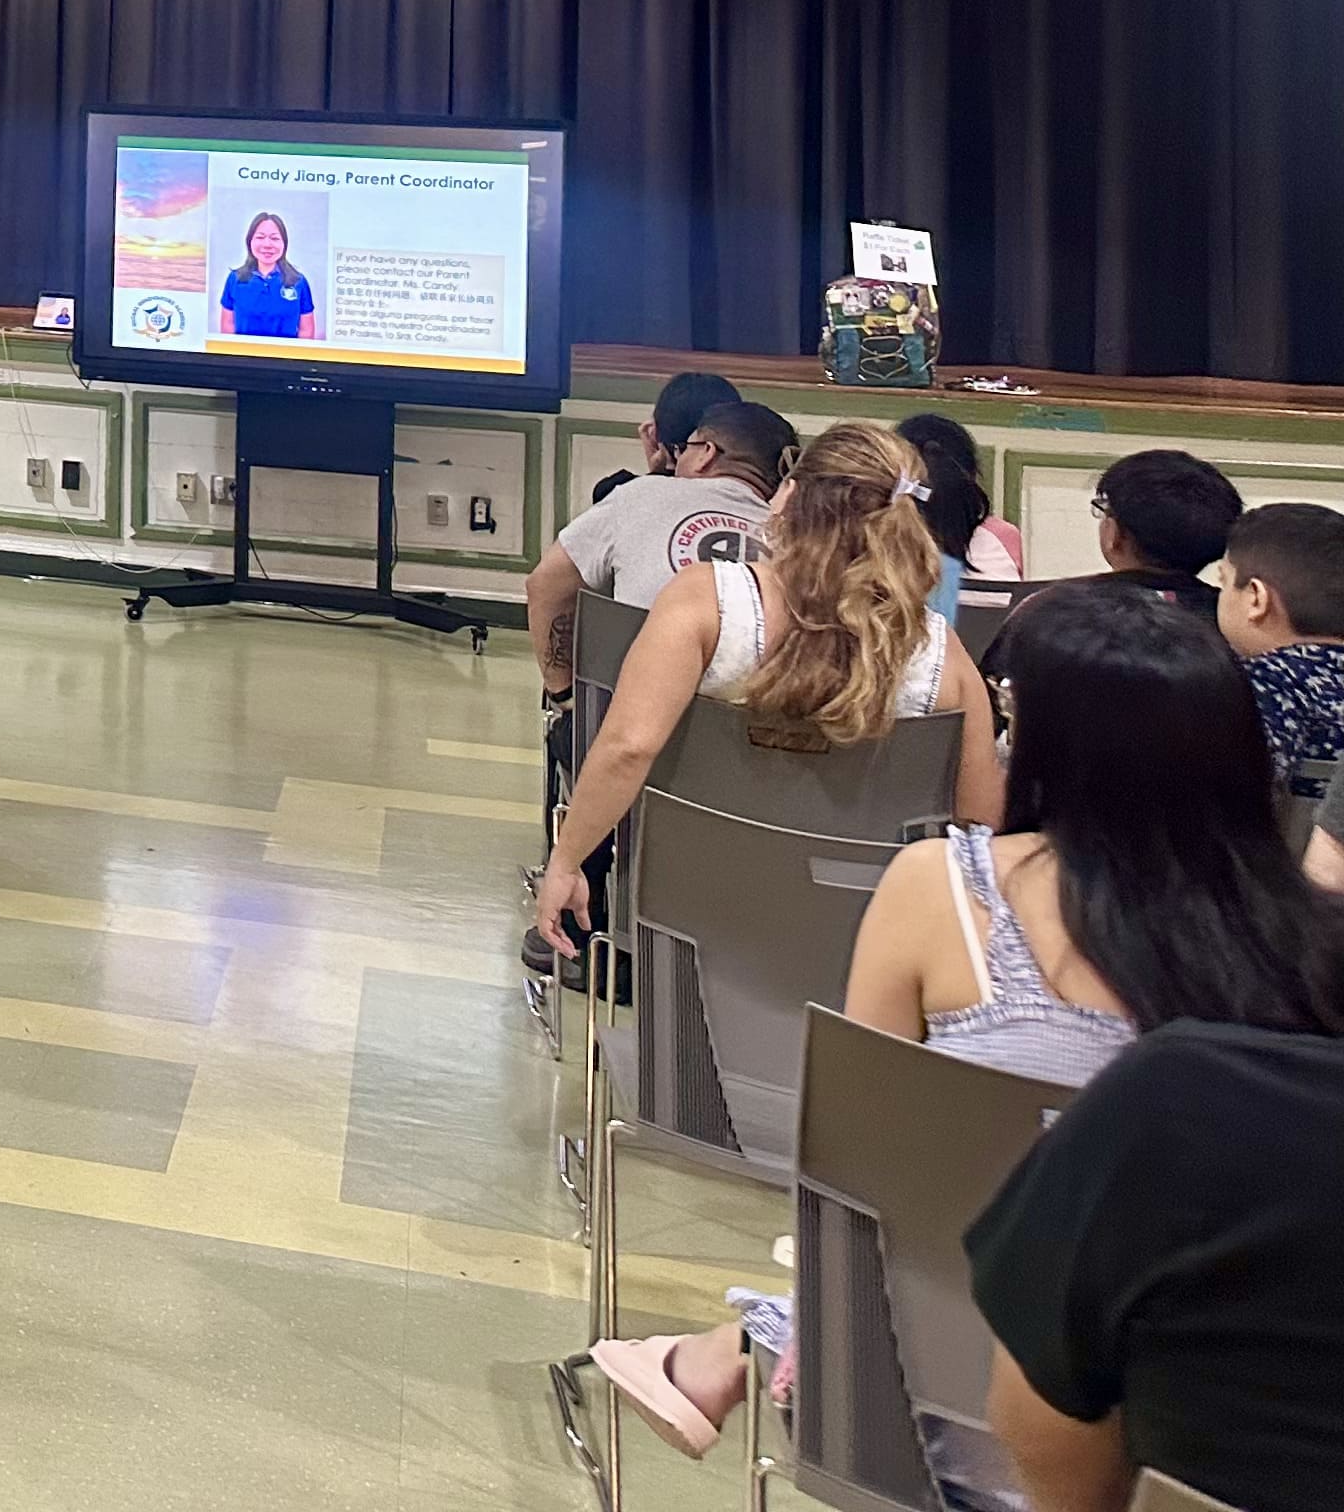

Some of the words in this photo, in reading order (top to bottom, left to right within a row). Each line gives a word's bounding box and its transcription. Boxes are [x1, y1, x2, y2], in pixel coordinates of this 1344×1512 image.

[238, 166, 290, 183] Candy
[294, 169, 341, 186] Jiang,
[345, 172, 395, 186] Parent
[400, 174, 494, 191] Coordinator
[369, 255, 396, 264] have
[398, 257, 418, 266] any
[336, 266, 370, 274] please
[372, 268, 413, 276] contact
[416, 269, 433, 277] our
[436, 270, 470, 279] Parent
[369, 309, 402, 320] alguna
[678, 516, 748, 546] CERTIFIED
